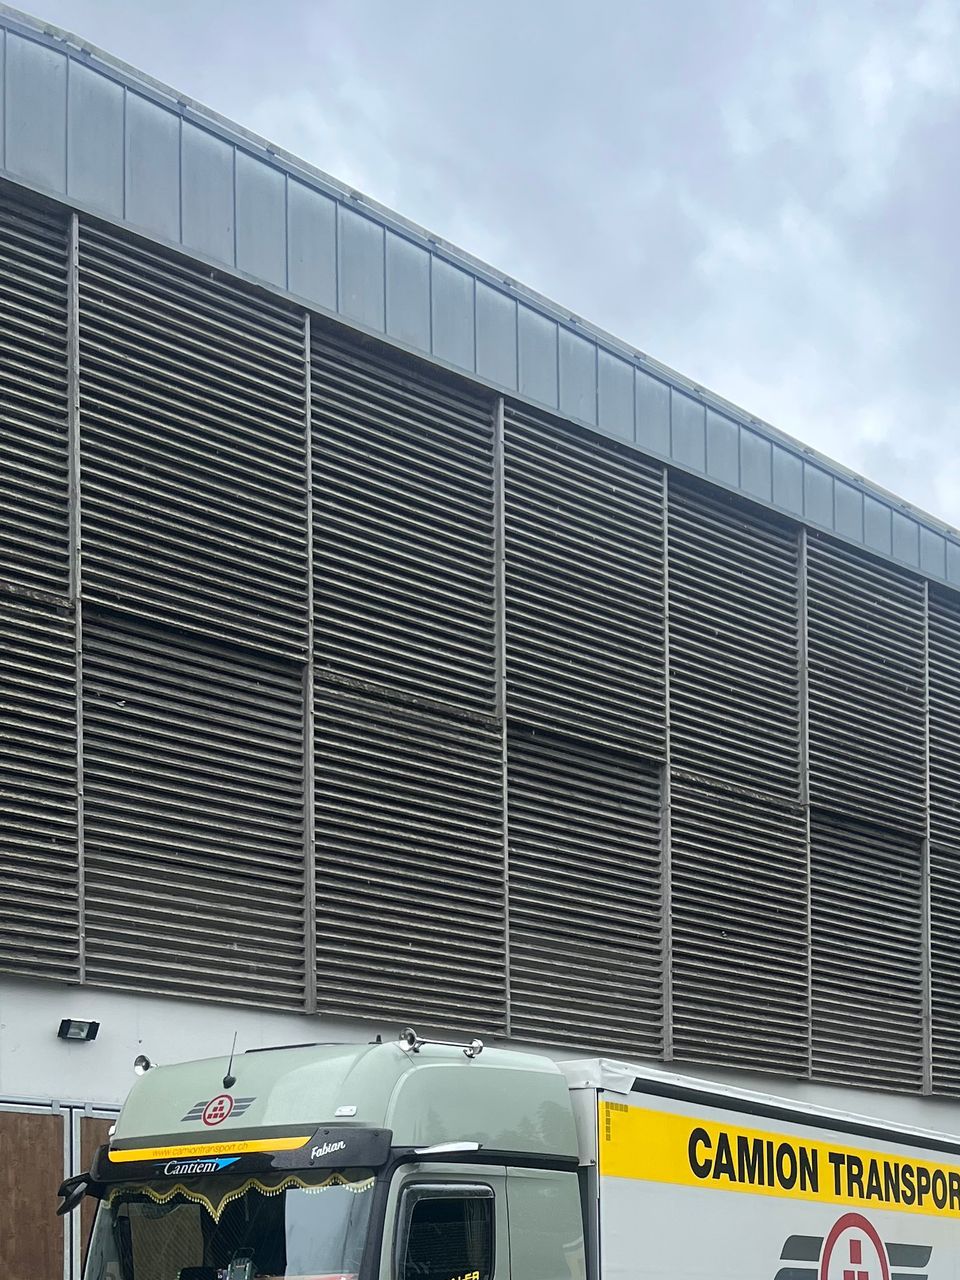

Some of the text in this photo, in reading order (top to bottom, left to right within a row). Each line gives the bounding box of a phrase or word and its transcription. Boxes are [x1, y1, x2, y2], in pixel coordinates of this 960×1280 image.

[152, 1143, 248, 1157] www.camiontransport.ch
[311, 1140, 346, 1160] Fabian
[164, 1158, 217, 1176] Cantieni
[687, 1127, 819, 1193] CAMION
